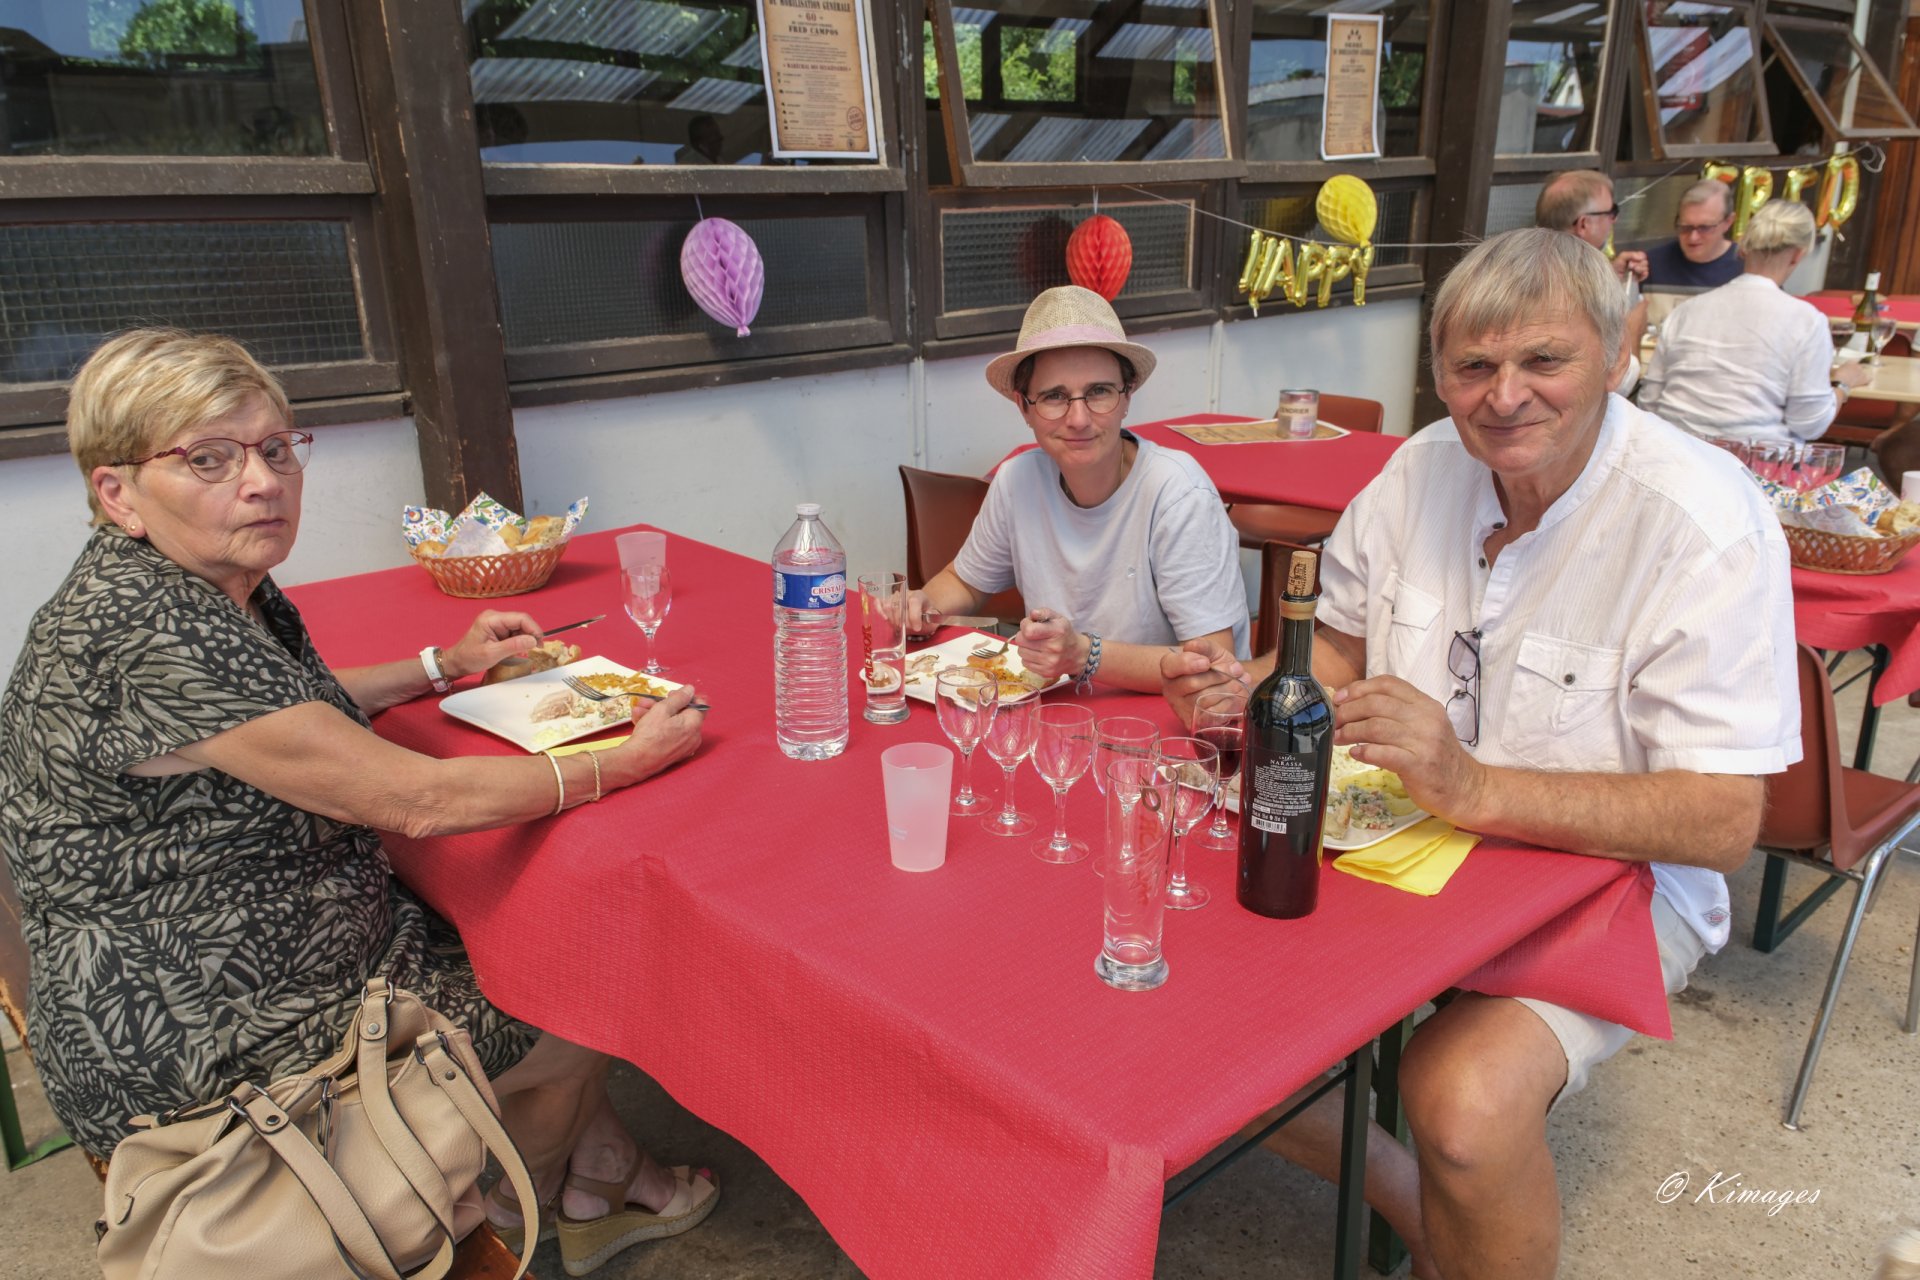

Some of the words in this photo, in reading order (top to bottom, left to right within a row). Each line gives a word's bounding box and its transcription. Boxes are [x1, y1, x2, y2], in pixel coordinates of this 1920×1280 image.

[788, 25, 808, 34] FRED
[810, 27, 839, 36] CAMPOS
[1239, 229, 1375, 308] HAPPY
[1270, 759, 1303, 767] NARASSA
